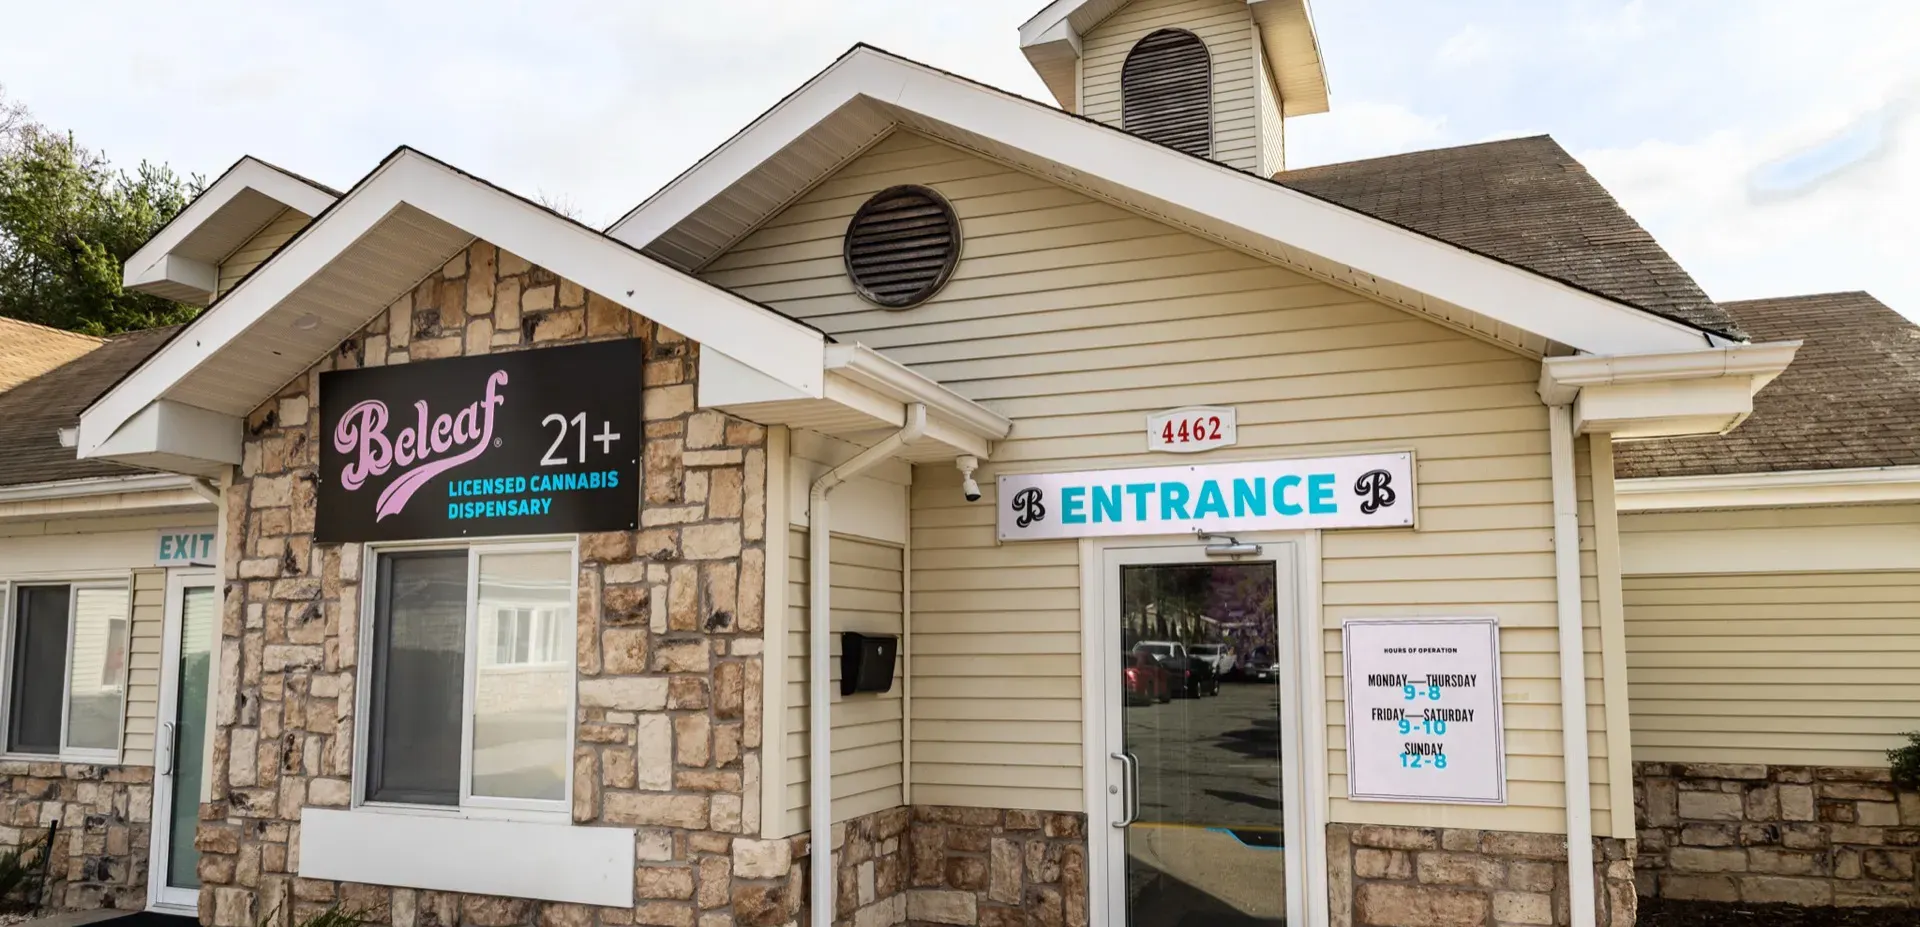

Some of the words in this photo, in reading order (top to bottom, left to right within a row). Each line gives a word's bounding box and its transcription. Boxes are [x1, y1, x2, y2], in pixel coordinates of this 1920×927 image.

[334, 370, 508, 490] Beleaf
[540, 411, 621, 466] 21+
[1161, 416, 1222, 444] 4462
[448, 476, 527, 497] LICENSED
[530, 470, 619, 493] CANNABIS
[448, 497, 552, 519] DISPENSARY
[1061, 473, 1338, 524] ENTRANCE
[160, 533, 214, 560] EXIT
[1404, 742, 1443, 756] SUNDAY
